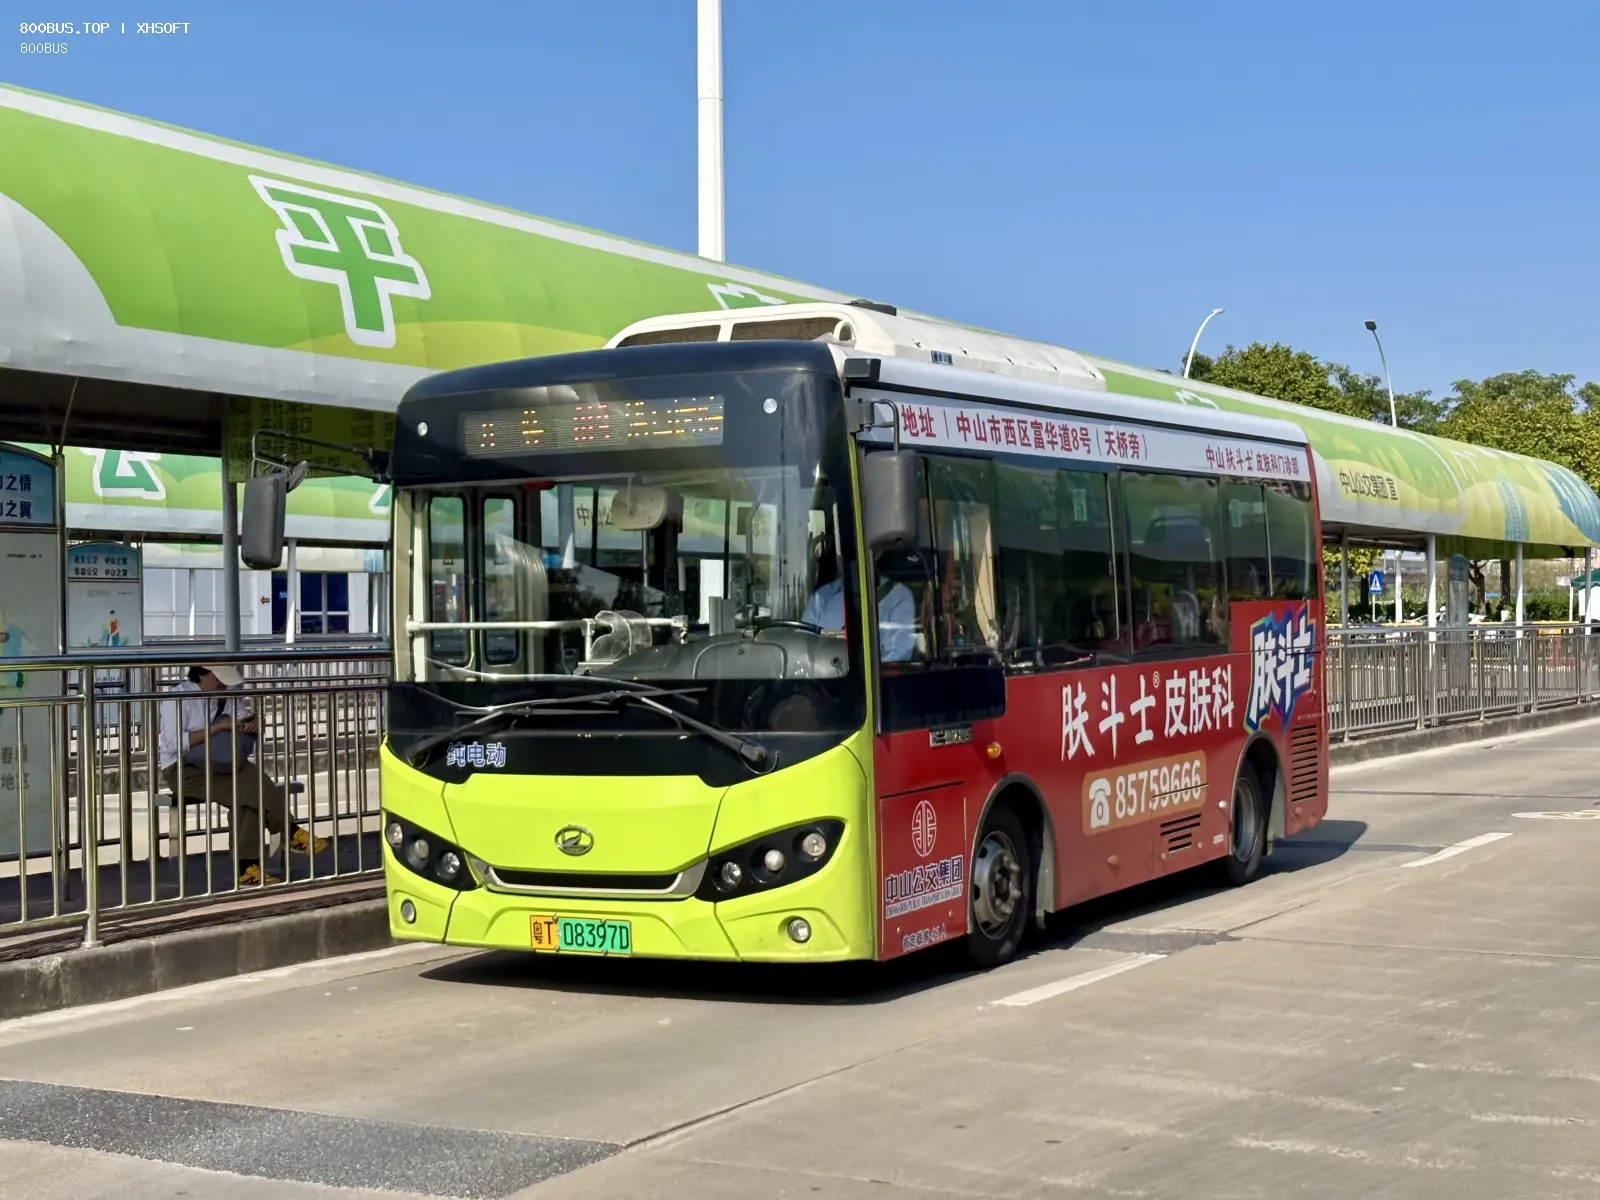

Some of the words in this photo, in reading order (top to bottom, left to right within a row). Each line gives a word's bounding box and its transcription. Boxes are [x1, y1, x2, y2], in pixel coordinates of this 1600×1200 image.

[247, 174, 432, 349] 平
[901, 404, 937, 438] 地址
[0, 473, 32, 492] 之情
[0, 500, 32, 519] 之翼
[446, 741, 507, 768] 纯电动
[1115, 759, 1202, 819] 85759666
[885, 855, 964, 903] 中山公交集团
